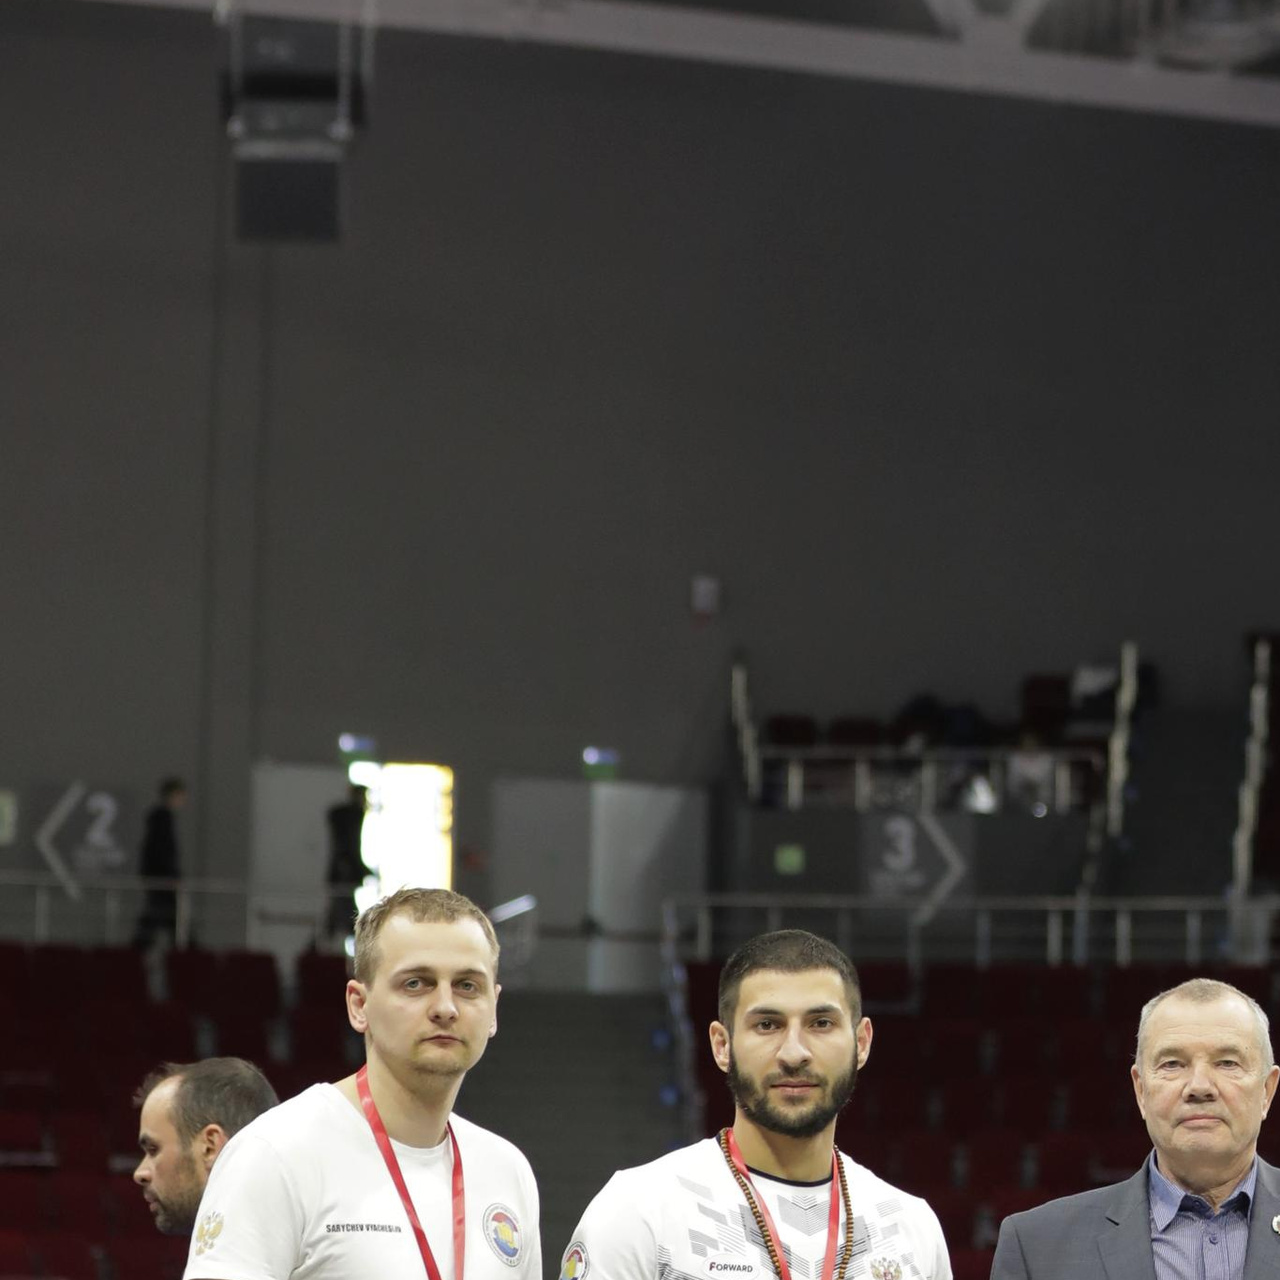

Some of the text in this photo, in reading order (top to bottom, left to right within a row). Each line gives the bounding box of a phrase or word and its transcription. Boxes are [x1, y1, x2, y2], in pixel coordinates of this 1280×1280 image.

[87, 791, 116, 847] 2
[326, 1224, 364, 1232] SARYCHEV
[709, 1262, 753, 1273] FORWARD
